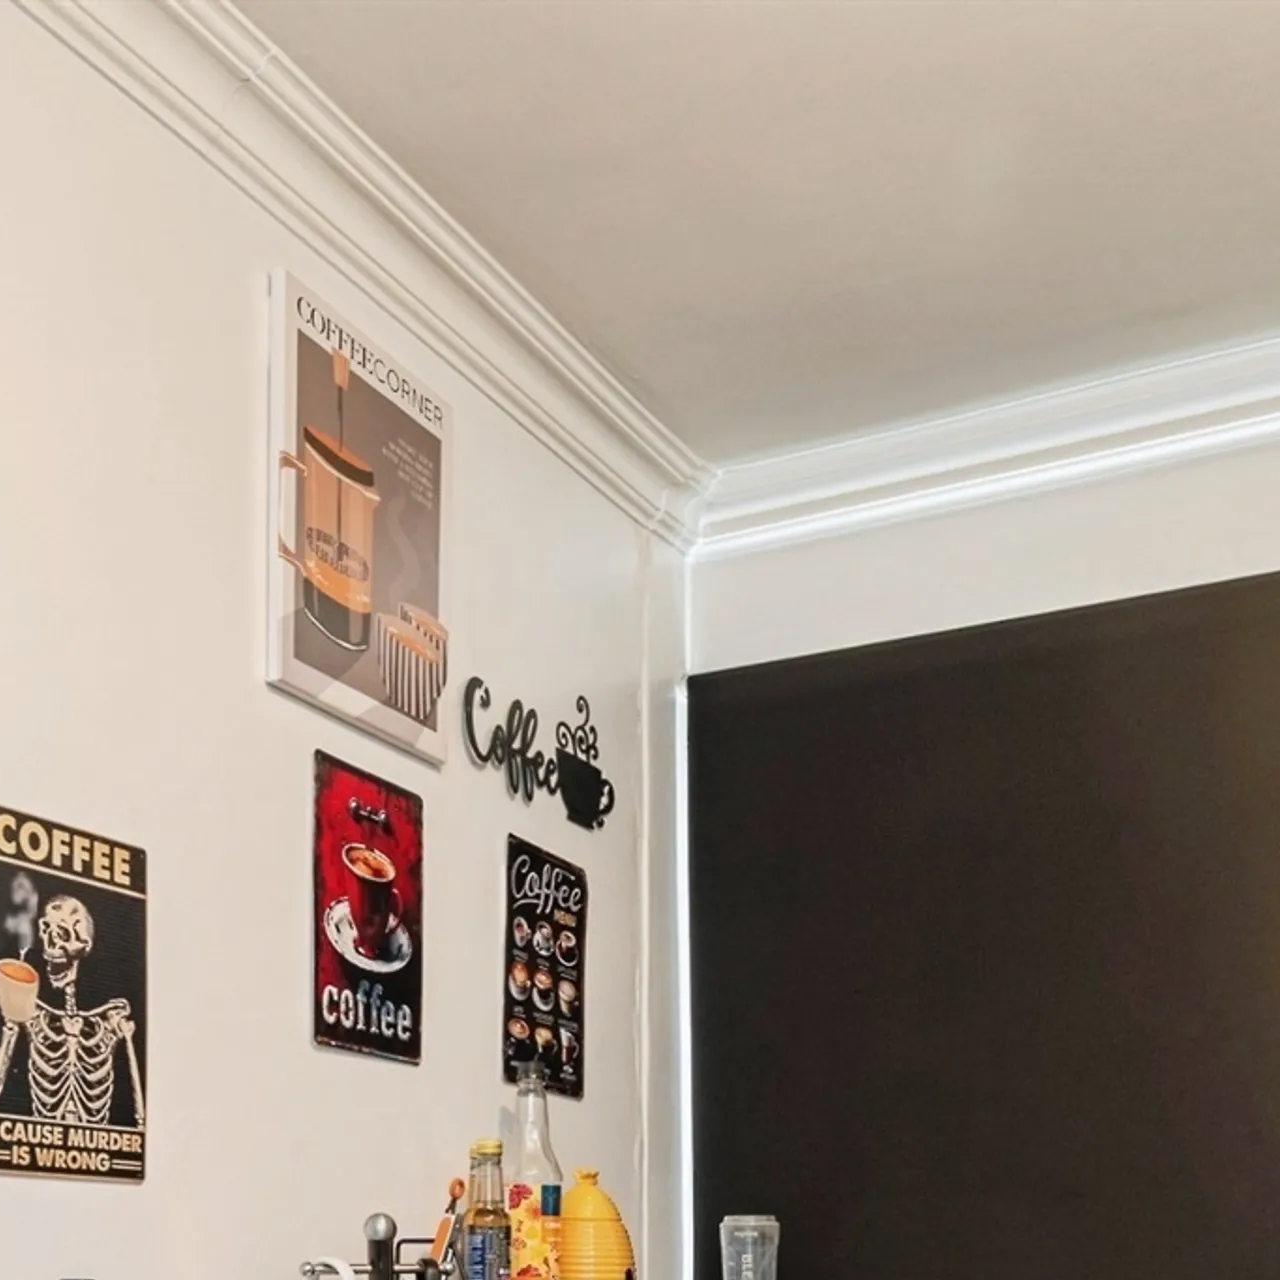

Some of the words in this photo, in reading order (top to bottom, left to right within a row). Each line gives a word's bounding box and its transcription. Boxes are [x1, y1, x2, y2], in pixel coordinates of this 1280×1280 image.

[463, 676, 560, 802] Coffee
[511, 854, 584, 914] Coffee
[11, 1145, 31, 1166] IS
[34, 1147, 111, 1172] WRONG
[68, 1128, 142, 1153] MURDER
